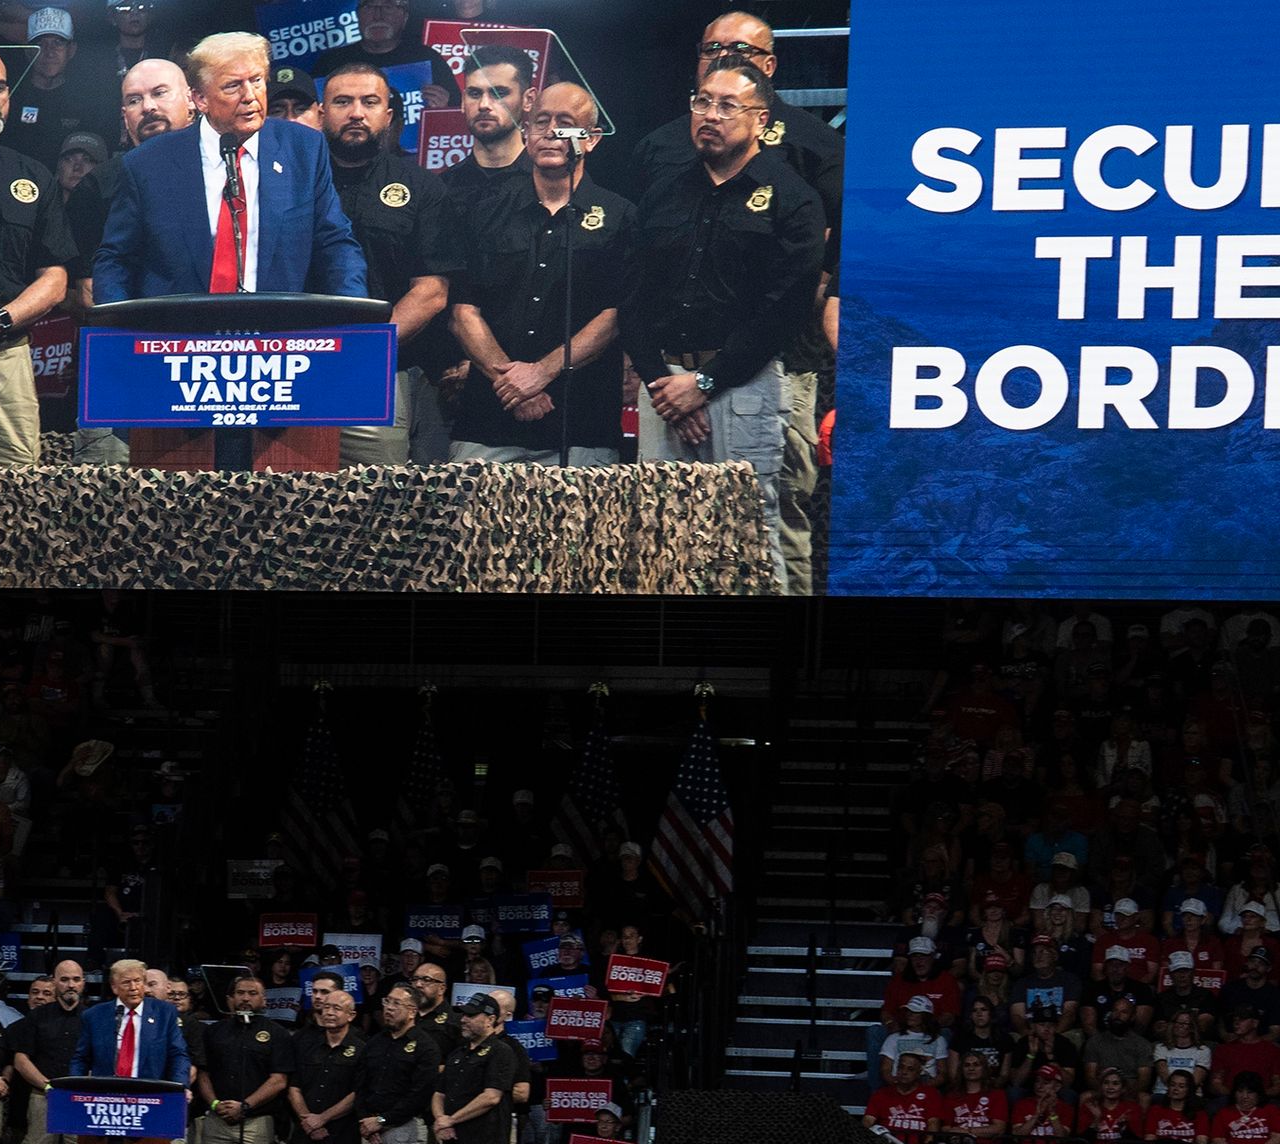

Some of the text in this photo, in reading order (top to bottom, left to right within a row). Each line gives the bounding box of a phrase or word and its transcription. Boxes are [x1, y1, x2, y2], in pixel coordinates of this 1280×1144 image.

[269, 17, 336, 42] SECURE
[906, 124, 1280, 213] SECU
[1035, 234, 1280, 320] THE
[45, 342, 72, 359] OUR
[141, 339, 336, 353] TEXT ARIZONA TO 88022
[163, 354, 311, 382] TRUMP
[179, 381, 293, 403] VANCE
[889, 344, 1280, 431] BORD
[238, 403, 267, 411] GREAT
[212, 413, 258, 426] 2024
[498, 910, 549, 920] BORDER
[409, 919, 460, 929] BORDER
[263, 927, 314, 937] BORDER
[610, 970, 663, 985] BORDER
[611, 965, 663, 978] SECURE OUR
[552, 1009, 602, 1018] SECURE OUR
[550, 1016, 601, 1028] BORDER
[551, 1091, 608, 1100] SECURE OUR
[83, 1103, 150, 1117] TRUMP
[90, 1115, 142, 1126] VANCE
